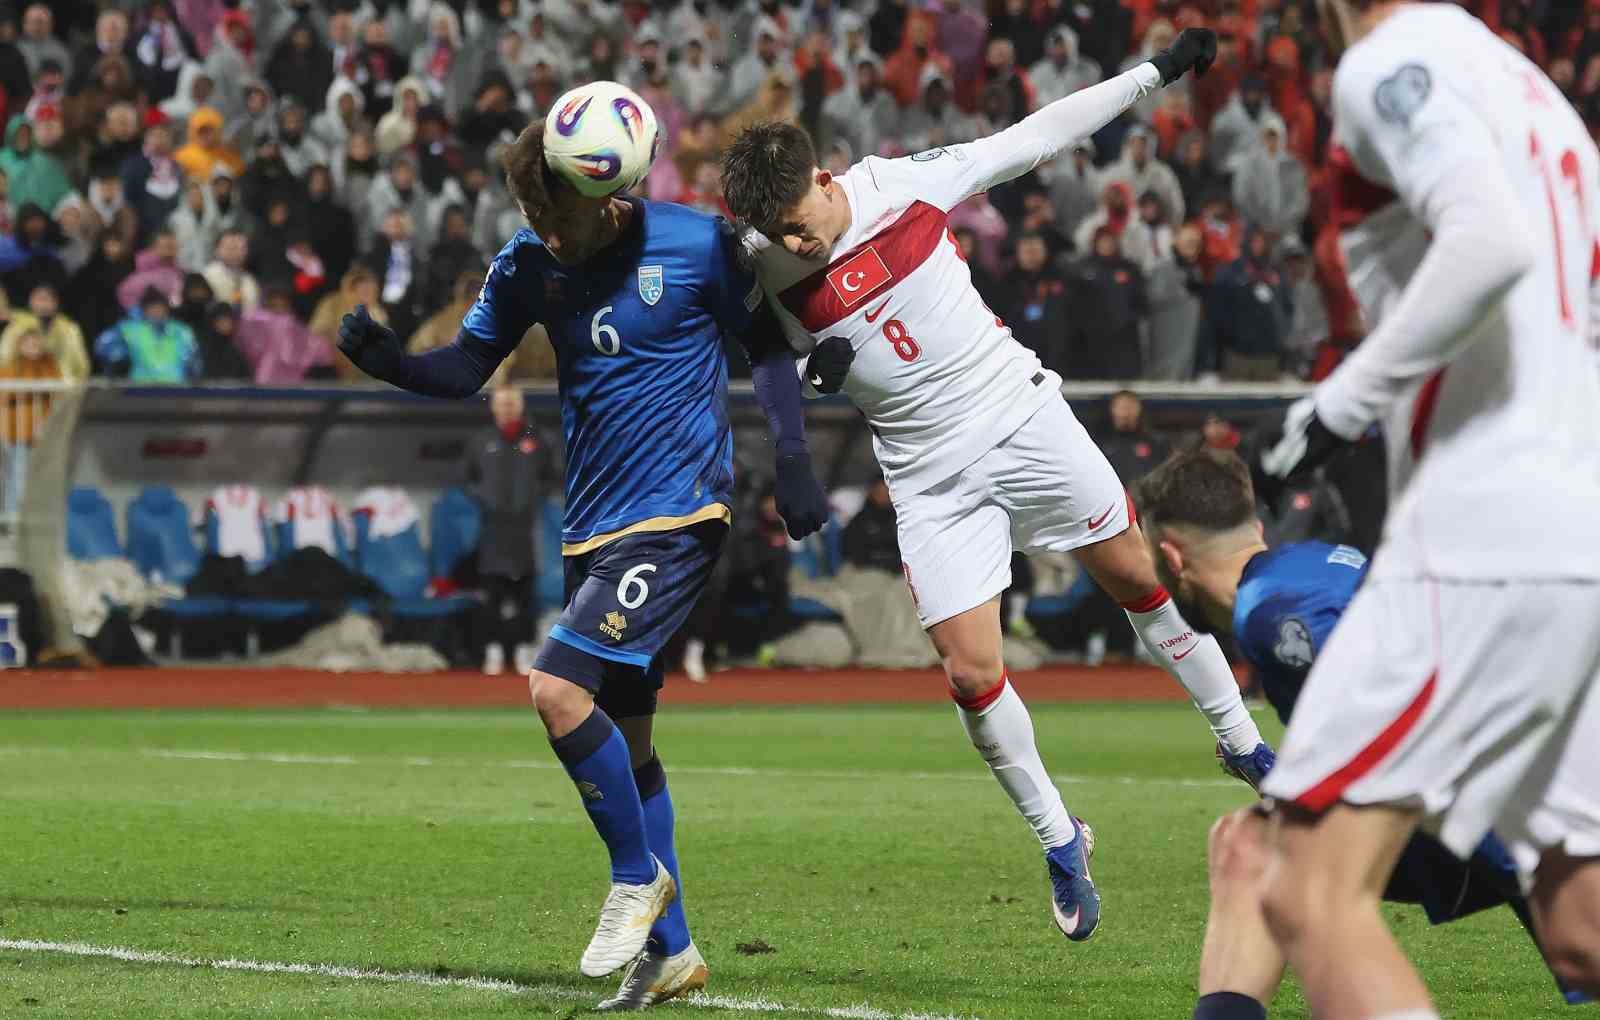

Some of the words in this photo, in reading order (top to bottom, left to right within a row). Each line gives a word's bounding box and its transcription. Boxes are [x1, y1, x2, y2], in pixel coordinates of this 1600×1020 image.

[591, 306, 620, 356] 6
[882, 319, 922, 363] 8
[617, 563, 657, 609] 6
